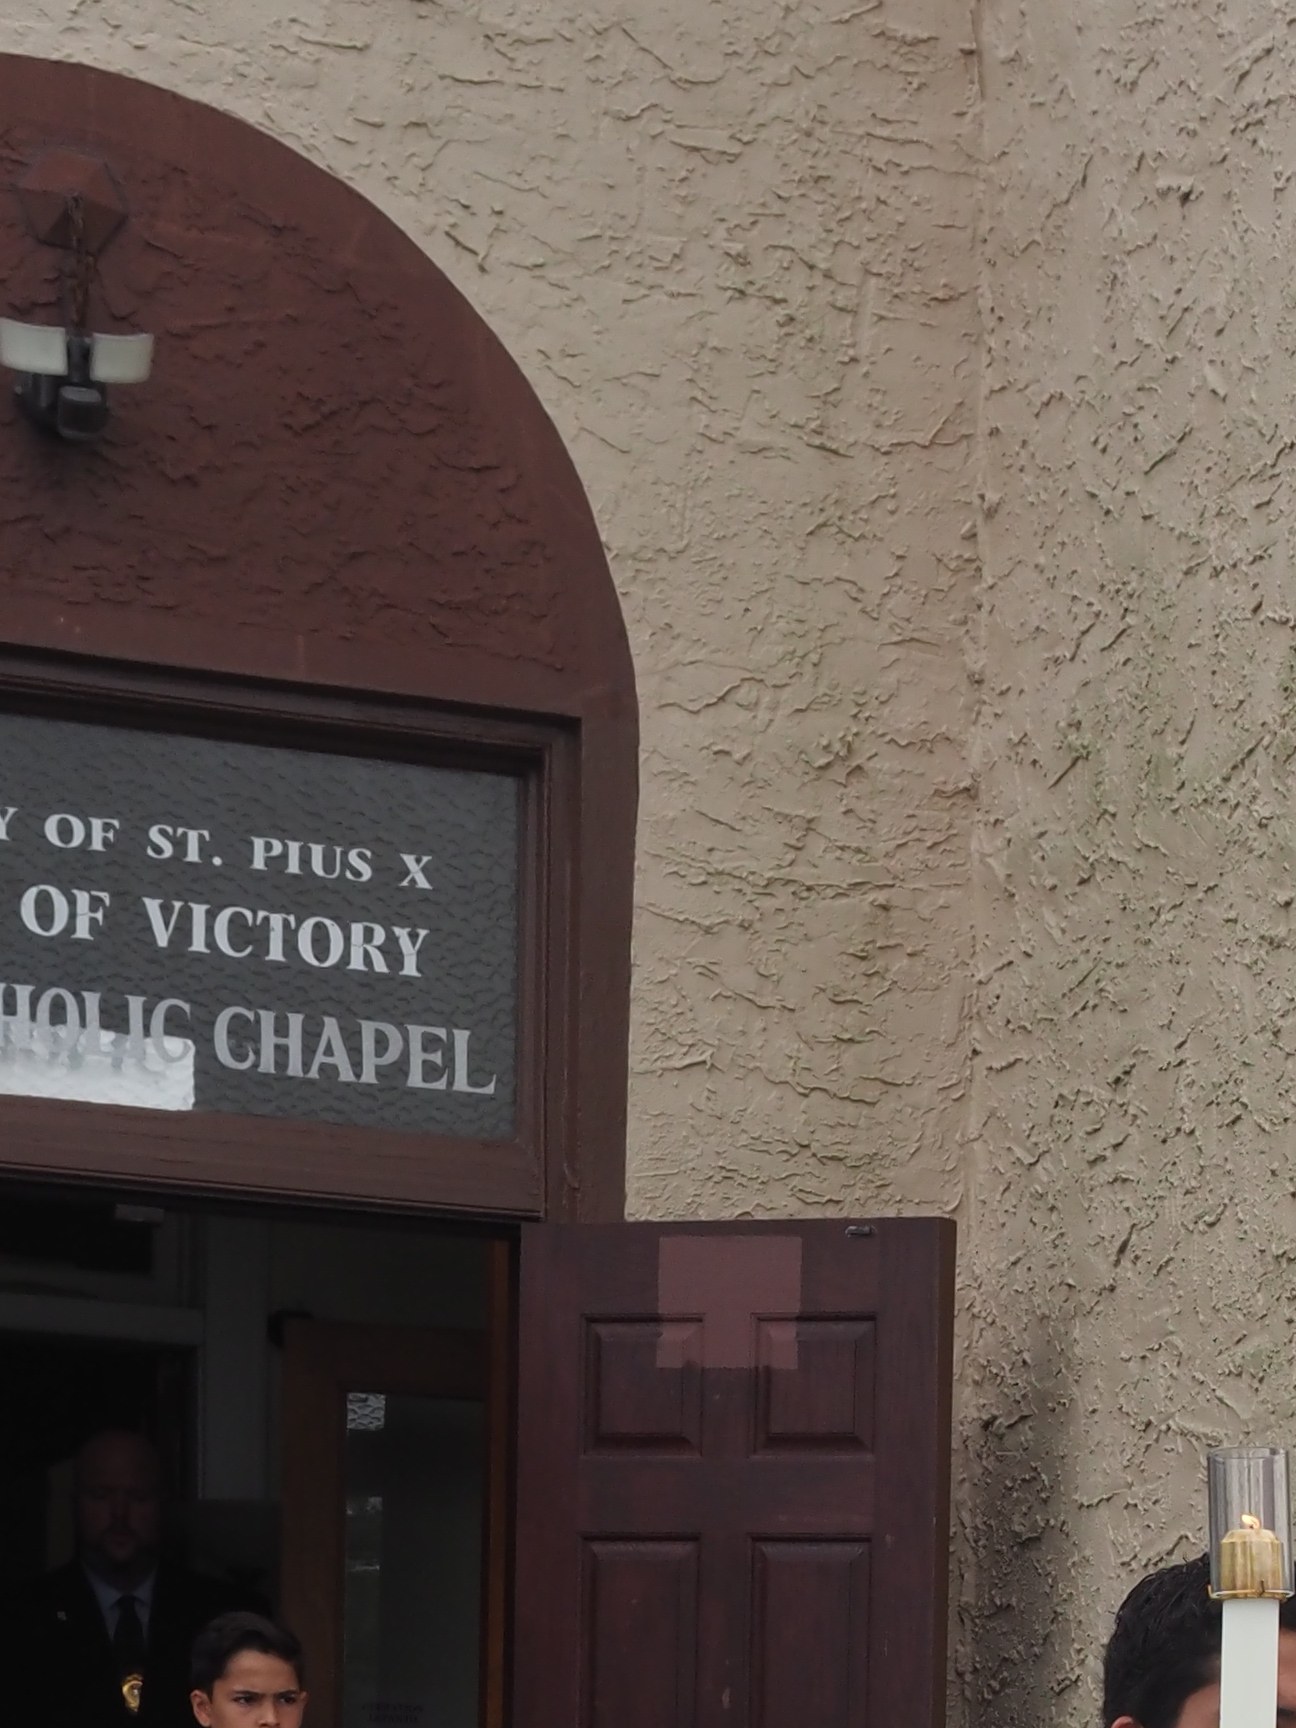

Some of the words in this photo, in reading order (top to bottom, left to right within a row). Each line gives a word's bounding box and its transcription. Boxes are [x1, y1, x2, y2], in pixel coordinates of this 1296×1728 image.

[44, 813, 120, 851] OF
[146, 824, 223, 866] ST.
[250, 836, 373, 882] PIUS
[399, 853, 433, 889] X
[20, 884, 110, 940] OF
[142, 897, 430, 977] VICTORY
[213, 1006, 497, 1094] CHAPEL
